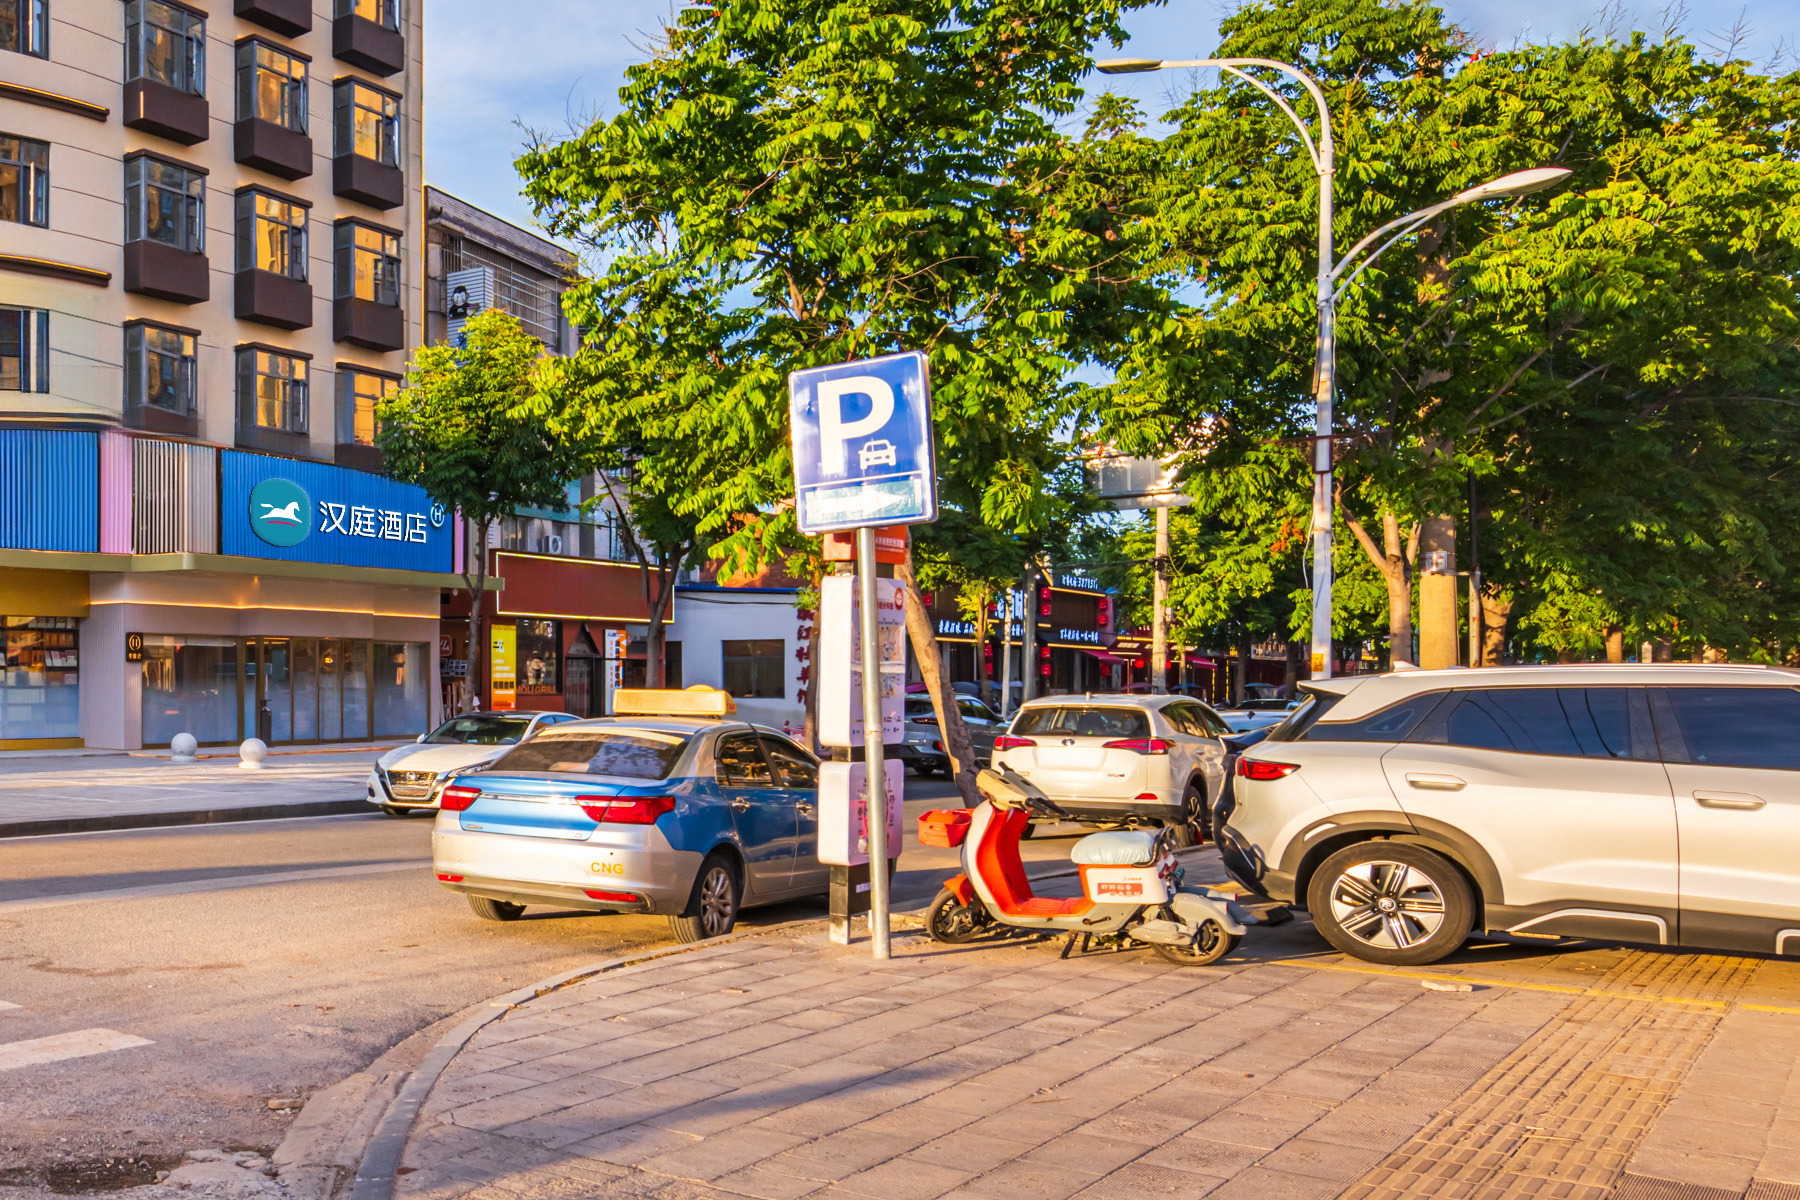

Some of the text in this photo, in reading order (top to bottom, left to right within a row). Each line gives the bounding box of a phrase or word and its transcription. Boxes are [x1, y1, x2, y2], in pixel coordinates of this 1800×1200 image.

[817, 375, 894, 477] P
[319, 501, 427, 543] 汉庭酒店
[535, 685, 557, 694] GRILL
[591, 862, 624, 875] CNG
